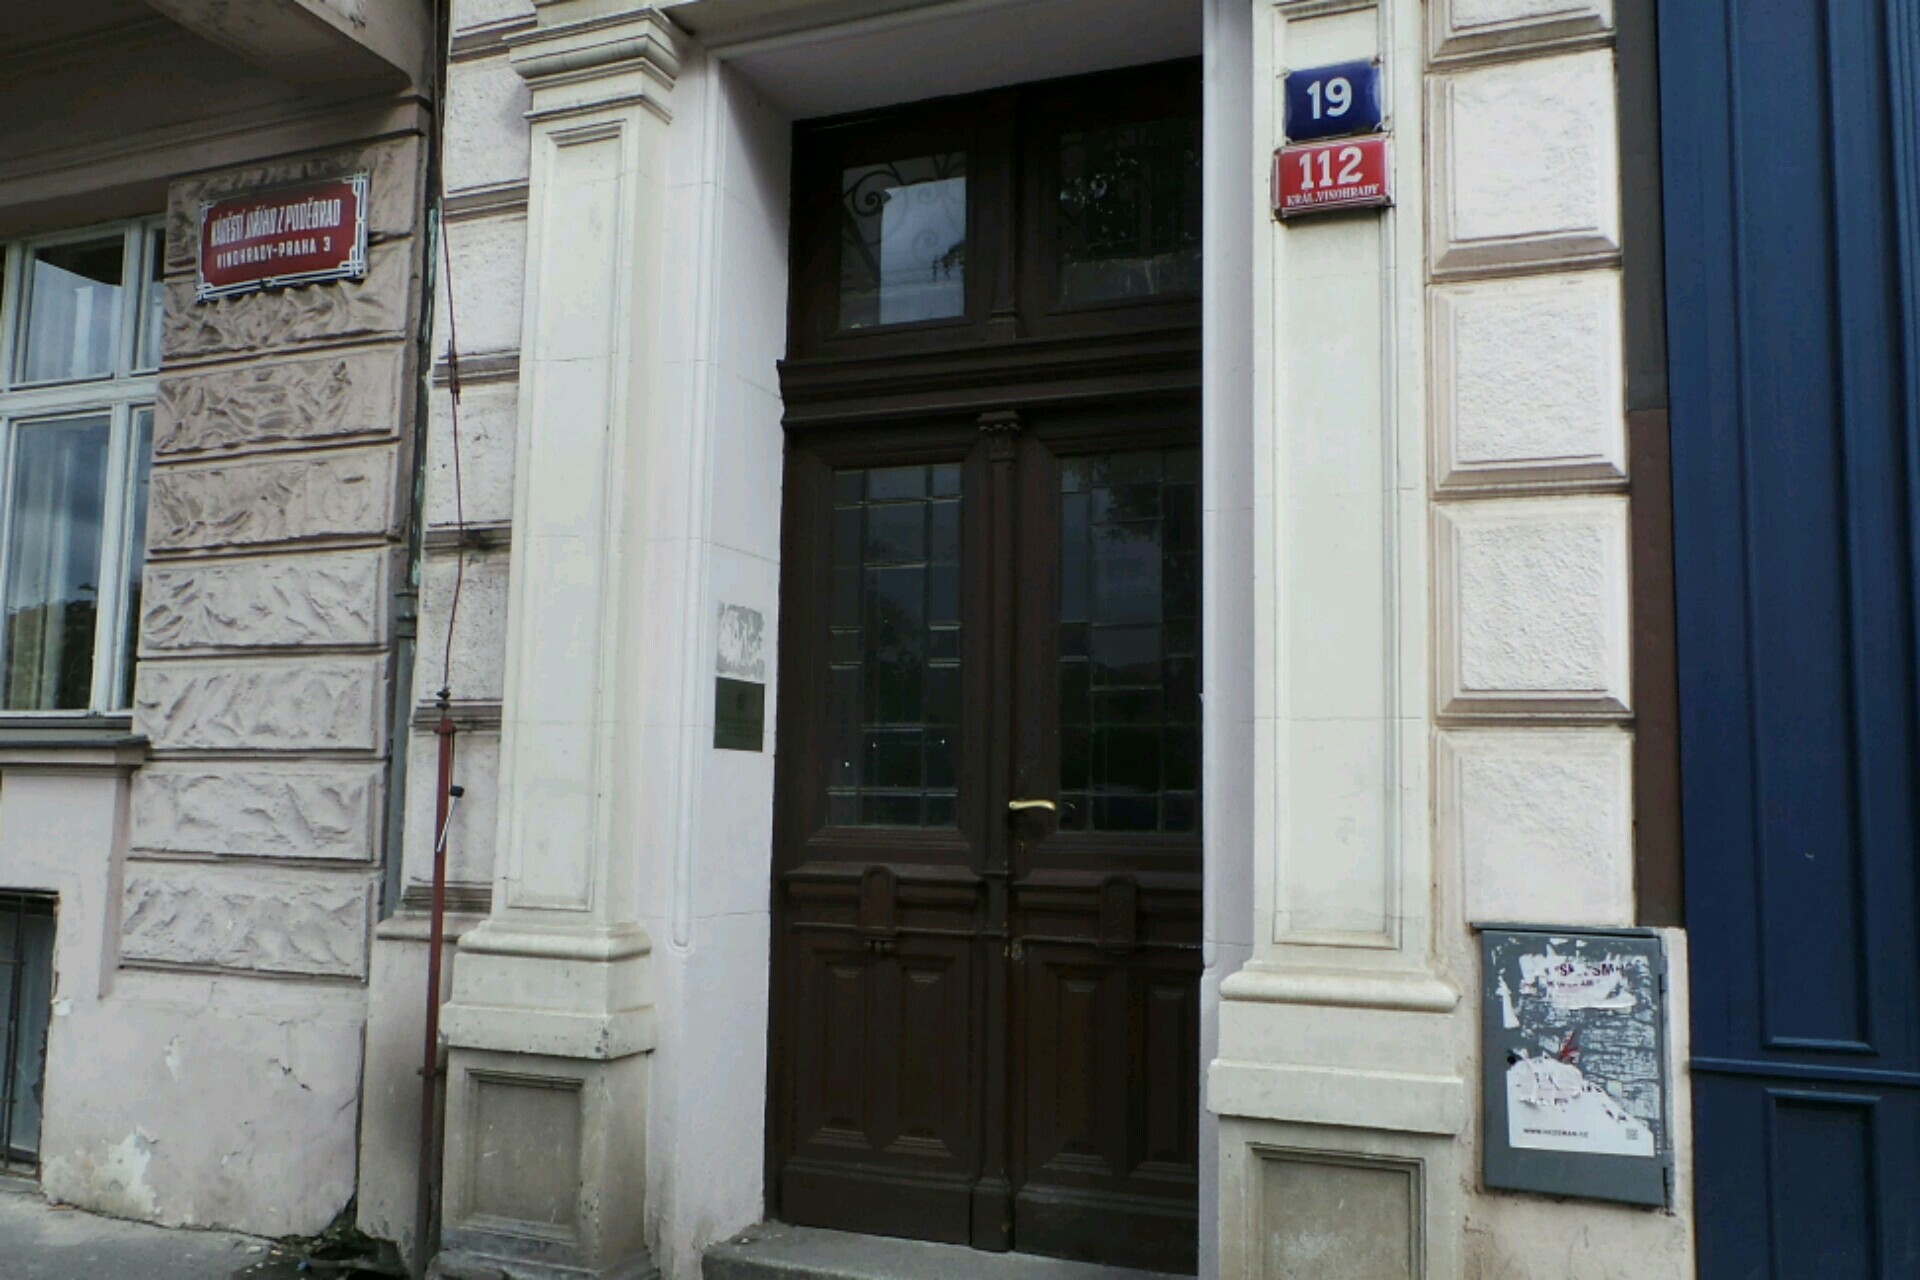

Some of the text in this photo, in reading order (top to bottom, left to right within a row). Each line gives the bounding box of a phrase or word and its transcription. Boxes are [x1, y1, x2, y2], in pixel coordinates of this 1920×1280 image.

[1306, 76, 1352, 120] 19
[1299, 146, 1364, 190] 112
[276, 206, 286, 234] Z
[323, 235, 332, 252] 3
